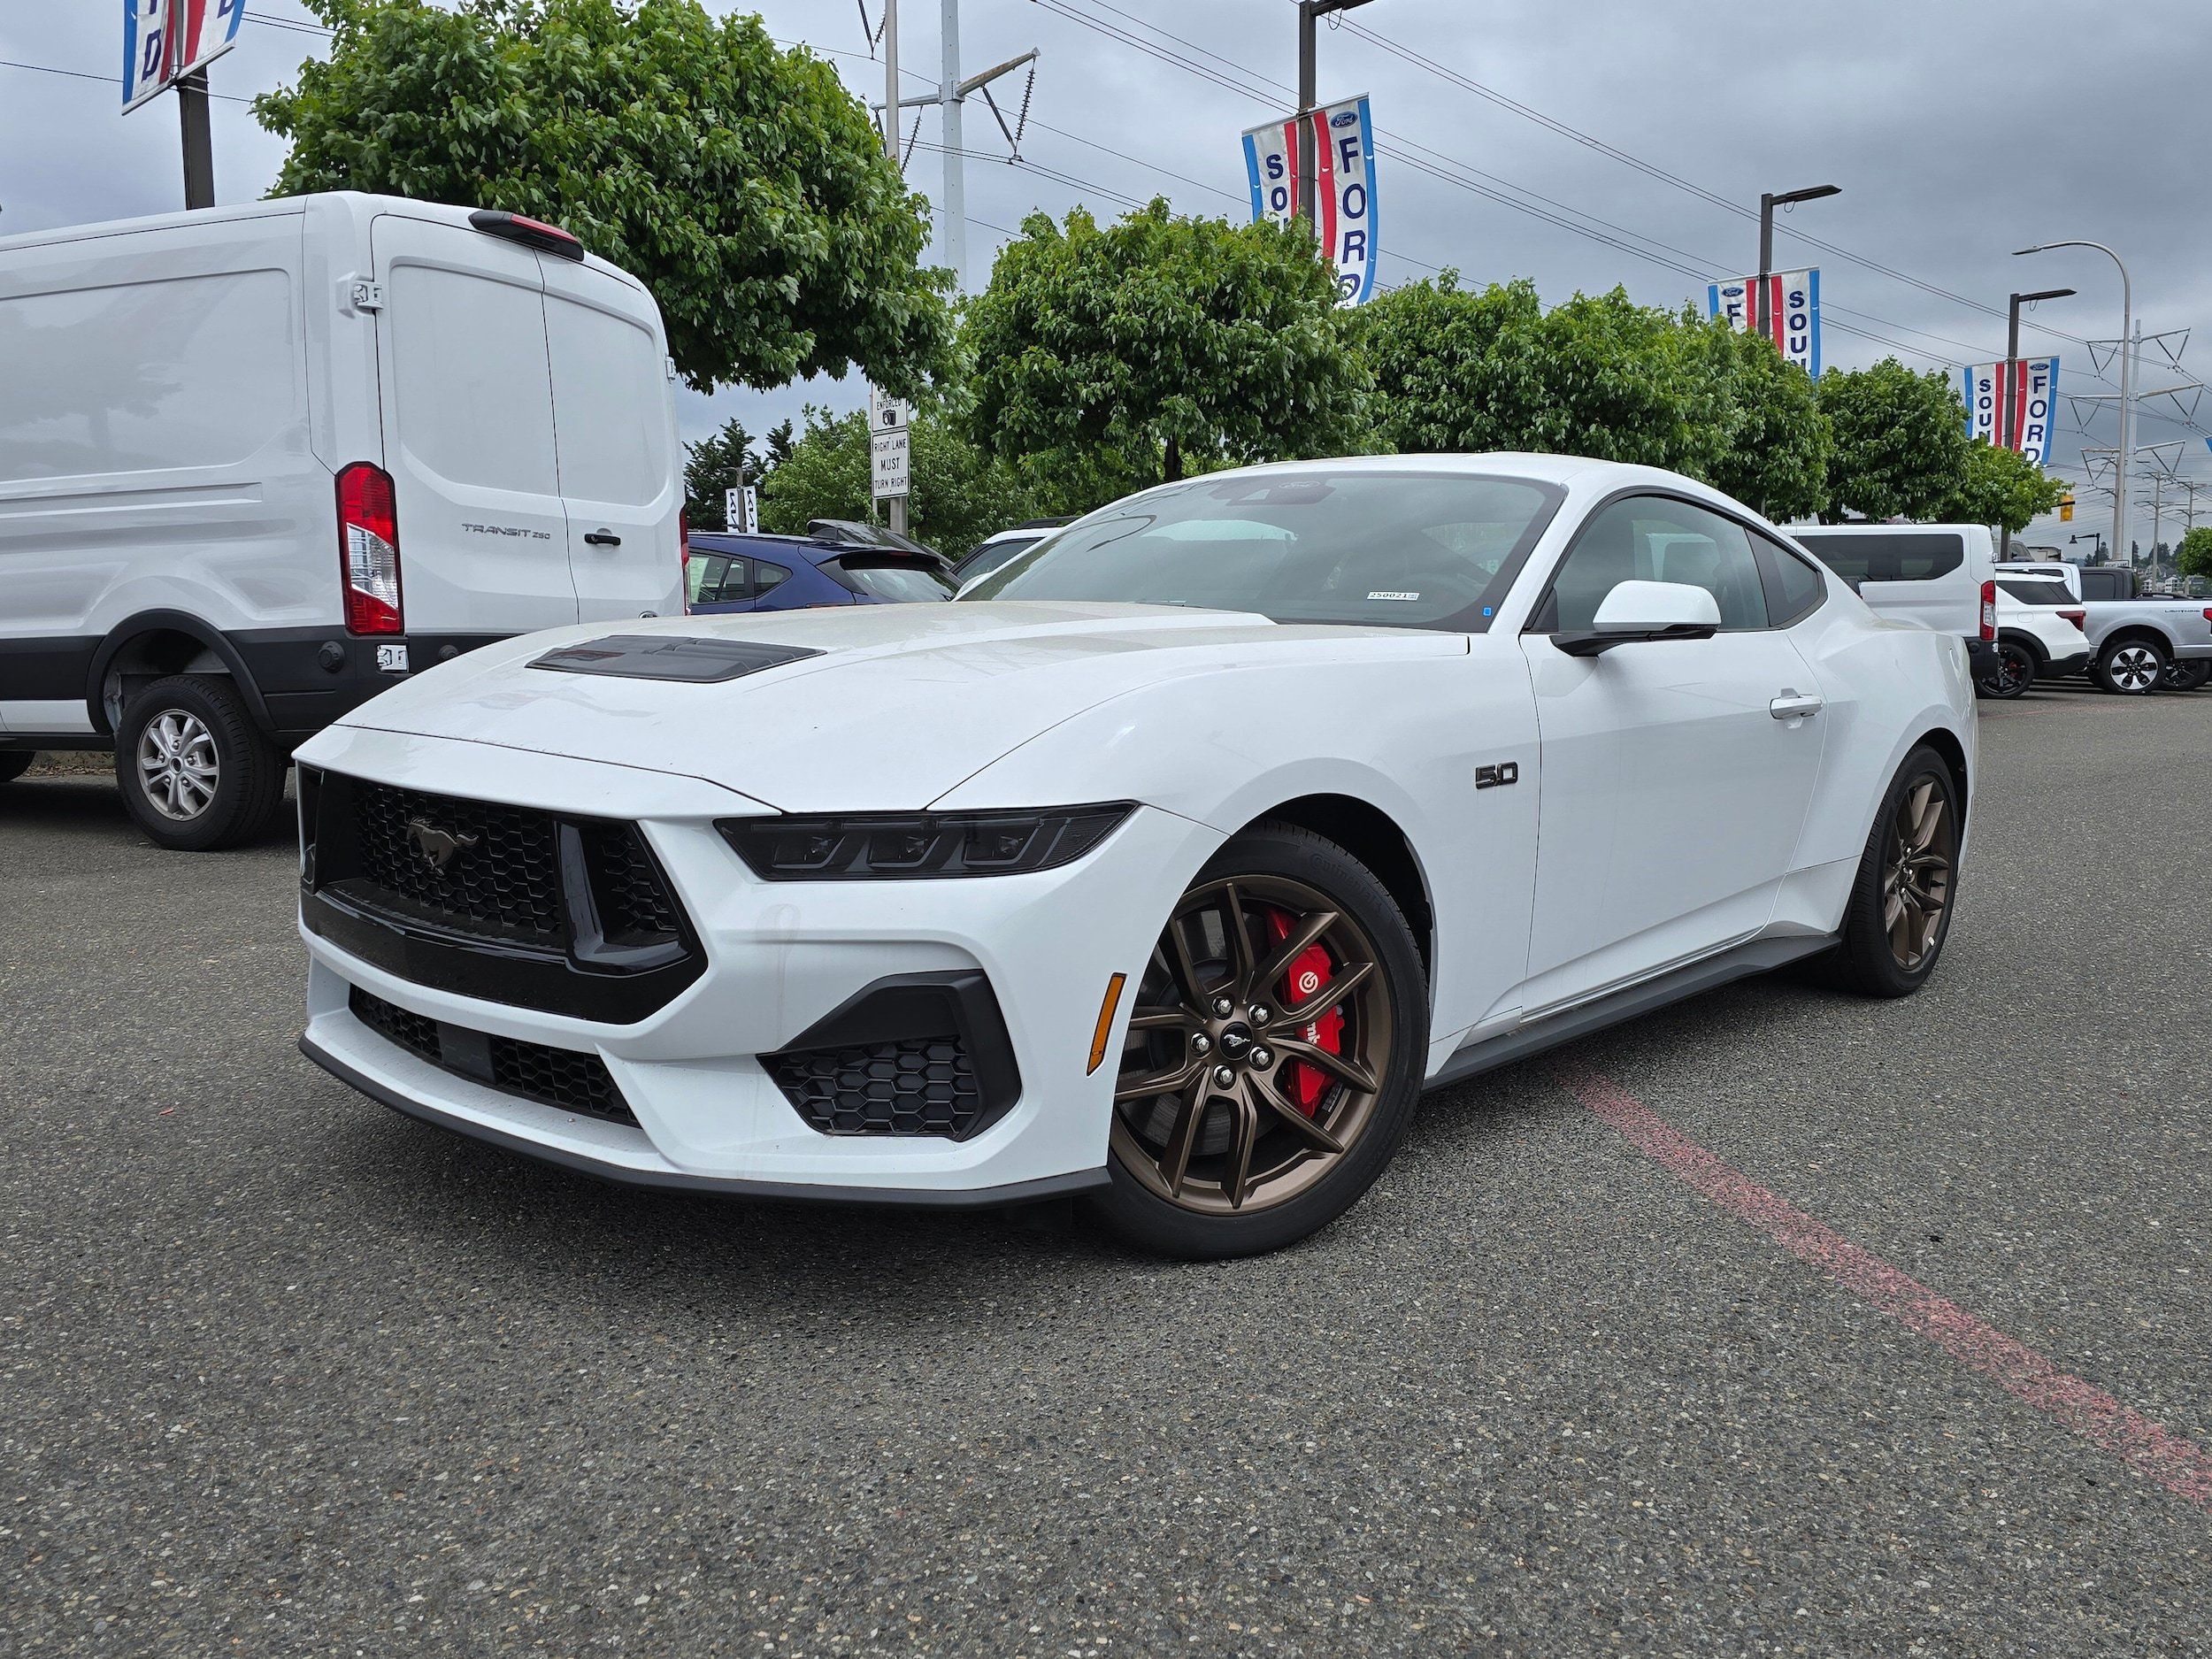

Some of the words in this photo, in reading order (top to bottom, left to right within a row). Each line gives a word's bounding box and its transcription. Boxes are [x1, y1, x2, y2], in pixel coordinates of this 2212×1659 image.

[874, 441, 889, 452] RIGHT
[892, 438, 907, 449] LANE
[880, 457, 900, 472] MUST
[874, 479, 888, 489] TURN
[891, 476, 907, 488] RIGHT
[462, 523, 531, 538] TRANSIT
[1475, 761, 1518, 790] 5.0
